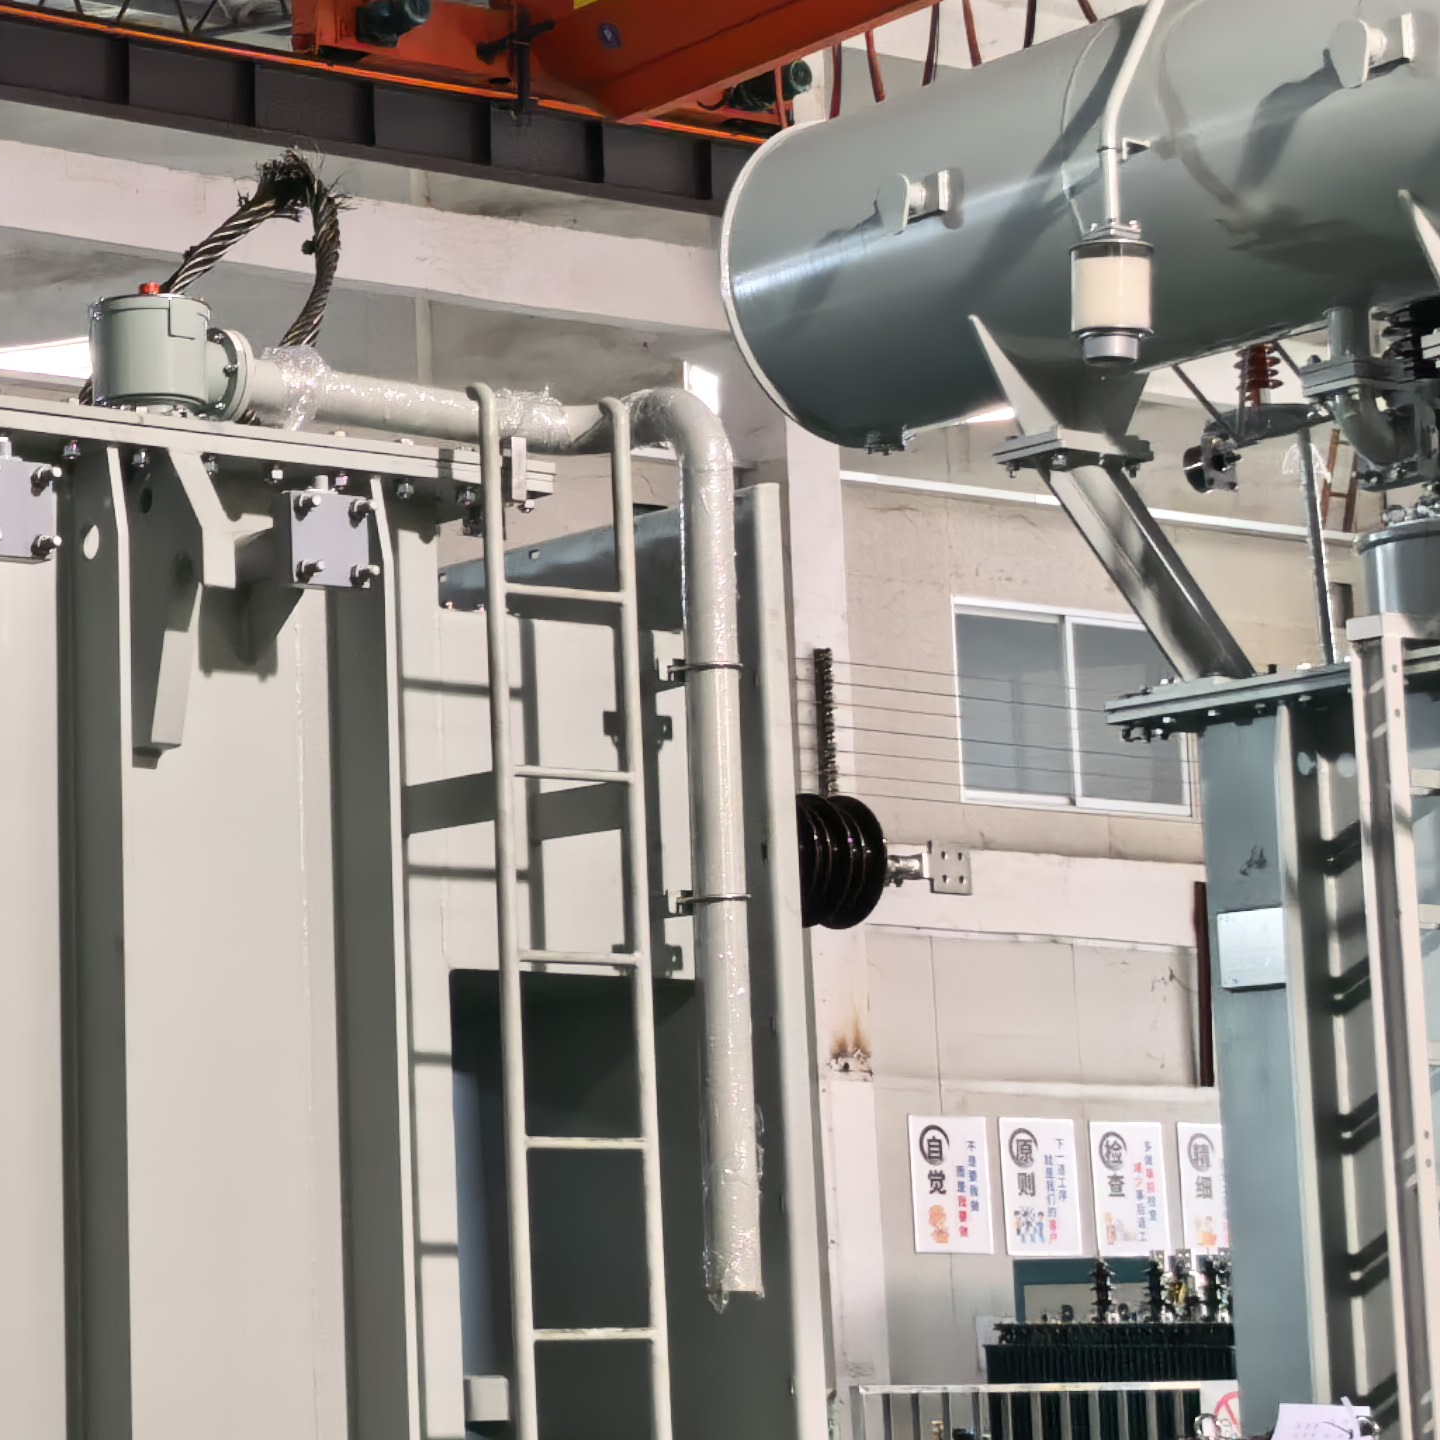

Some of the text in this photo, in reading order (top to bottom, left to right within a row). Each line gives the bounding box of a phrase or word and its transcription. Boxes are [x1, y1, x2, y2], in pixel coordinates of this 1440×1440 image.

[927, 1135, 947, 1195] 自觉
[1016, 1138, 1036, 1197] 原则
[1105, 1140, 1126, 1198] 检查
